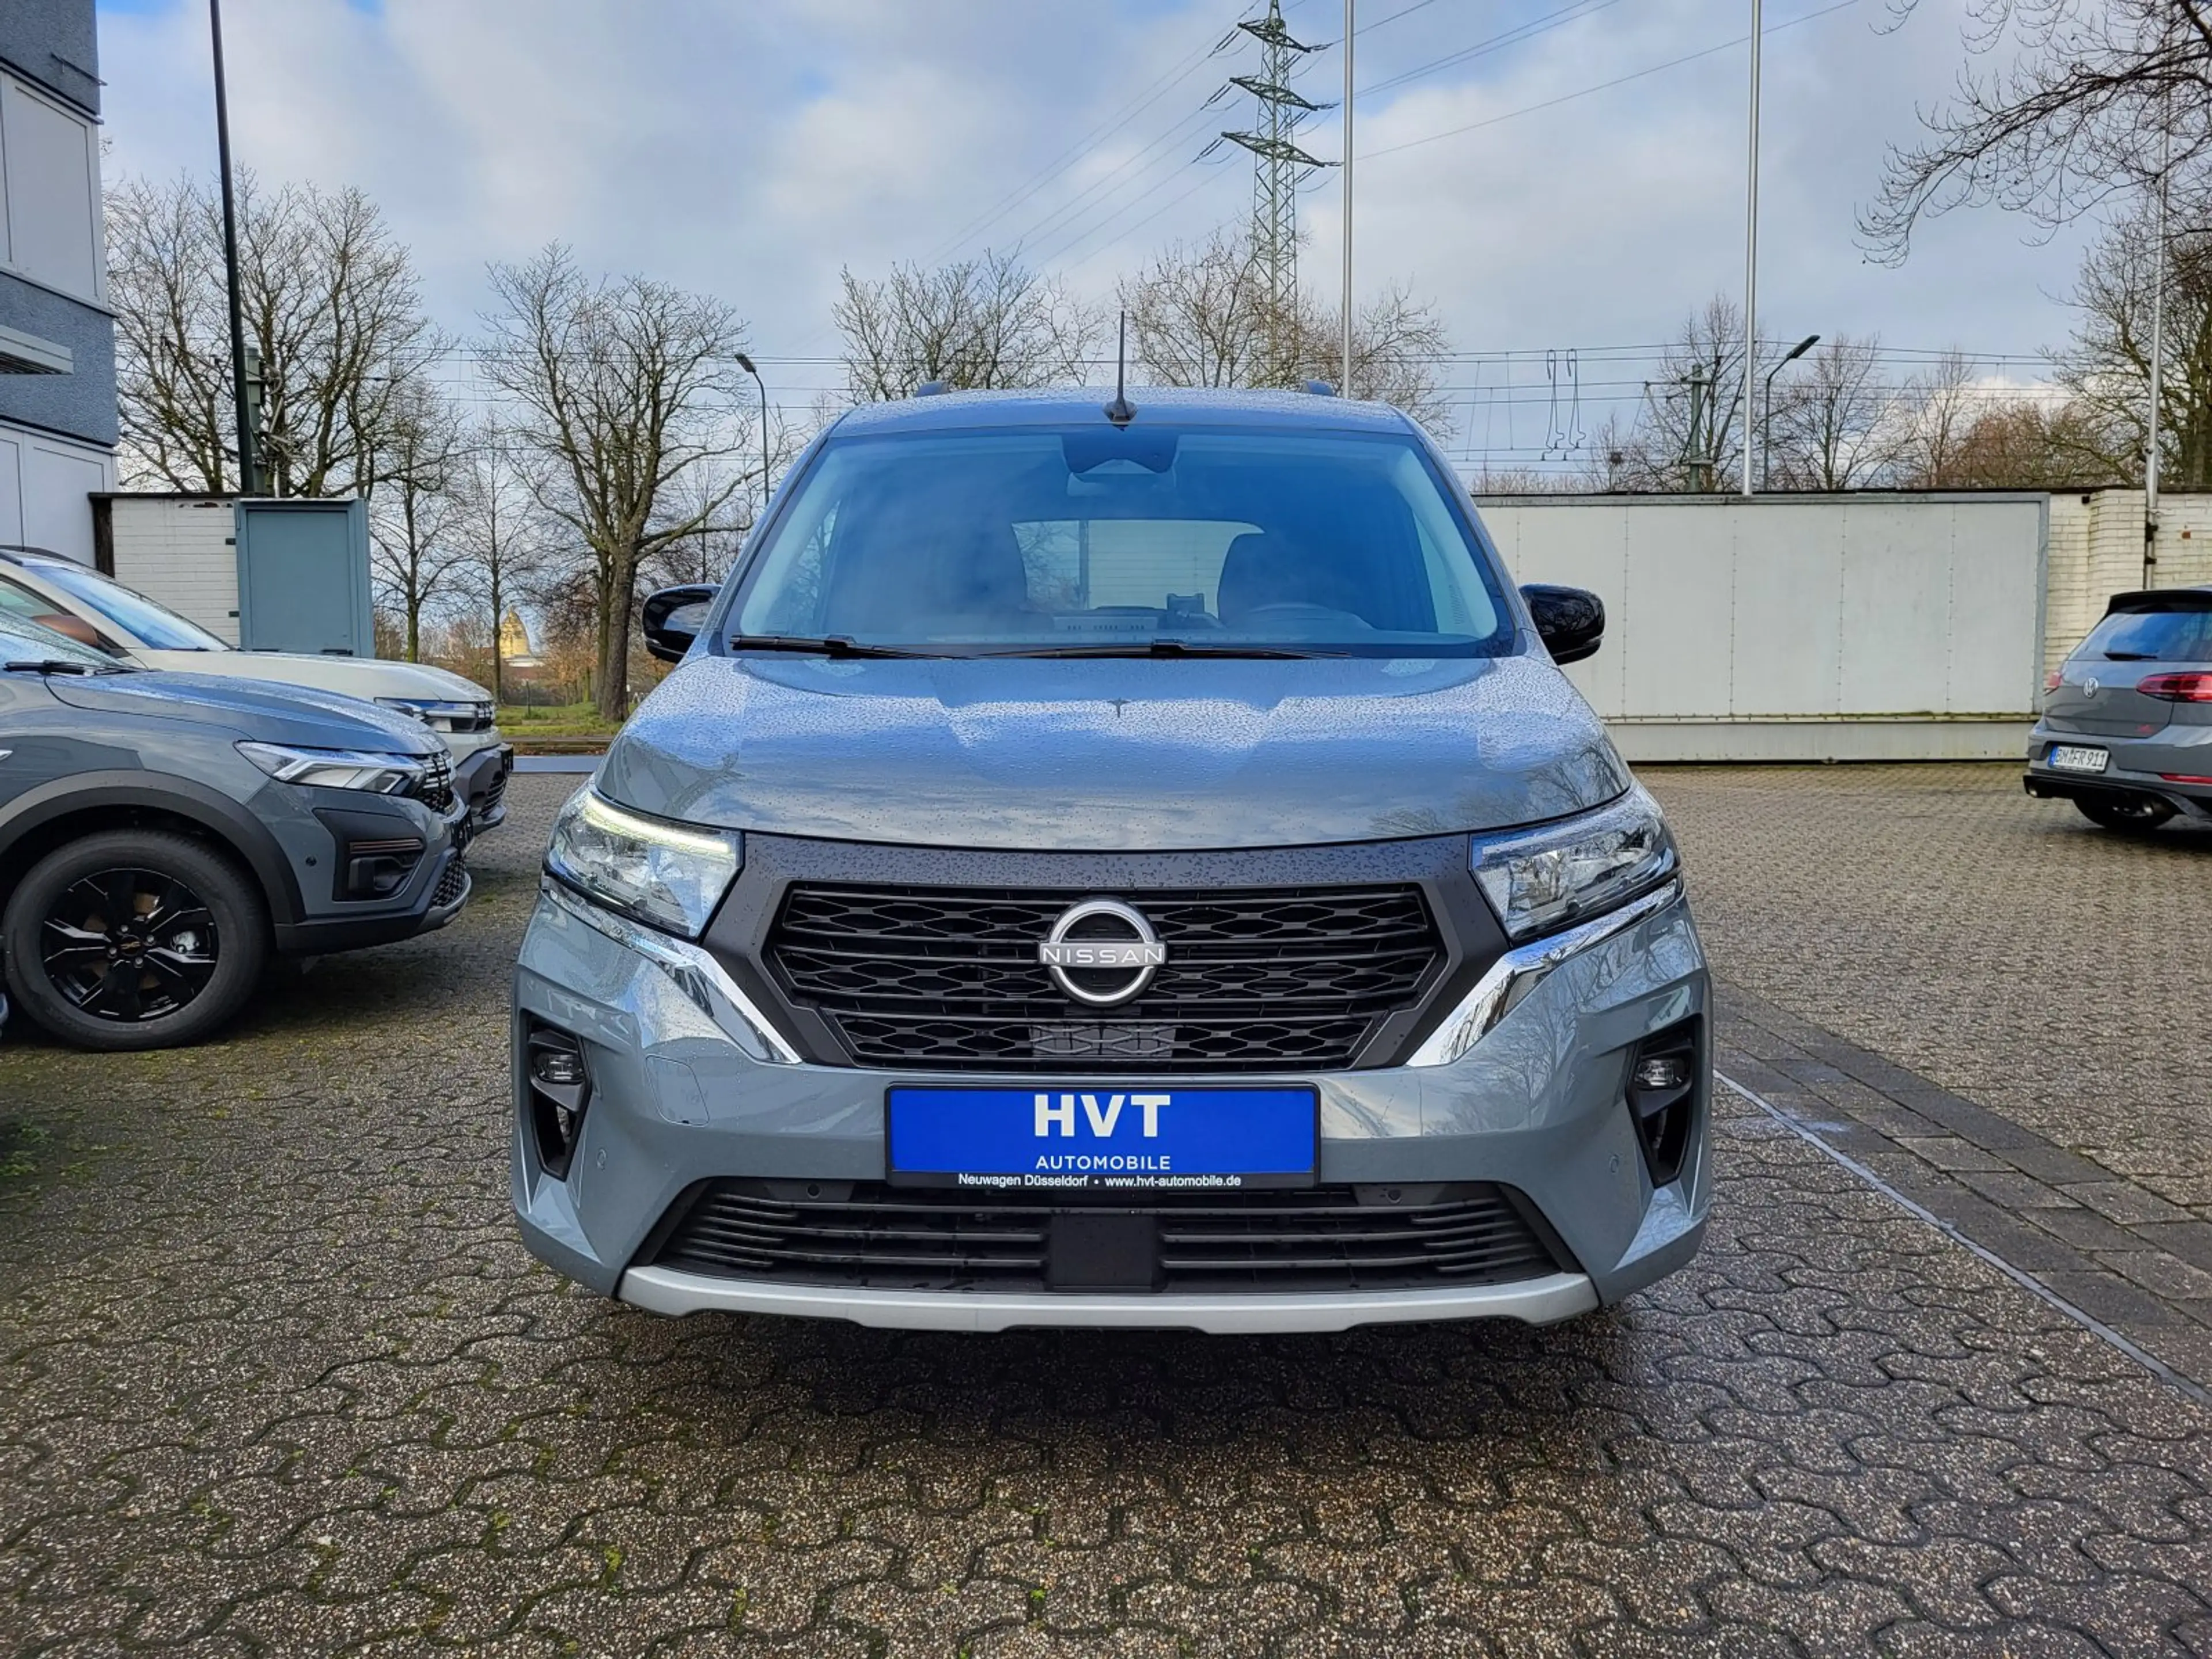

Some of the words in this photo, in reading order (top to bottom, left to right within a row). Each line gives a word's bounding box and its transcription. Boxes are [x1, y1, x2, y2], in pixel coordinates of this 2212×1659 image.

[2086, 752, 2105, 767] 911
[1043, 948, 1162, 963] NISSAN
[1035, 1094, 1171, 1137] HVT
[1036, 1156, 1171, 1170] AUTOMOBILE
[959, 1173, 1021, 1188] Neuwagen
[1024, 1175, 1089, 1187] Düsseldorf
[1105, 1175, 1241, 1187] www.hvt-automobile.de
